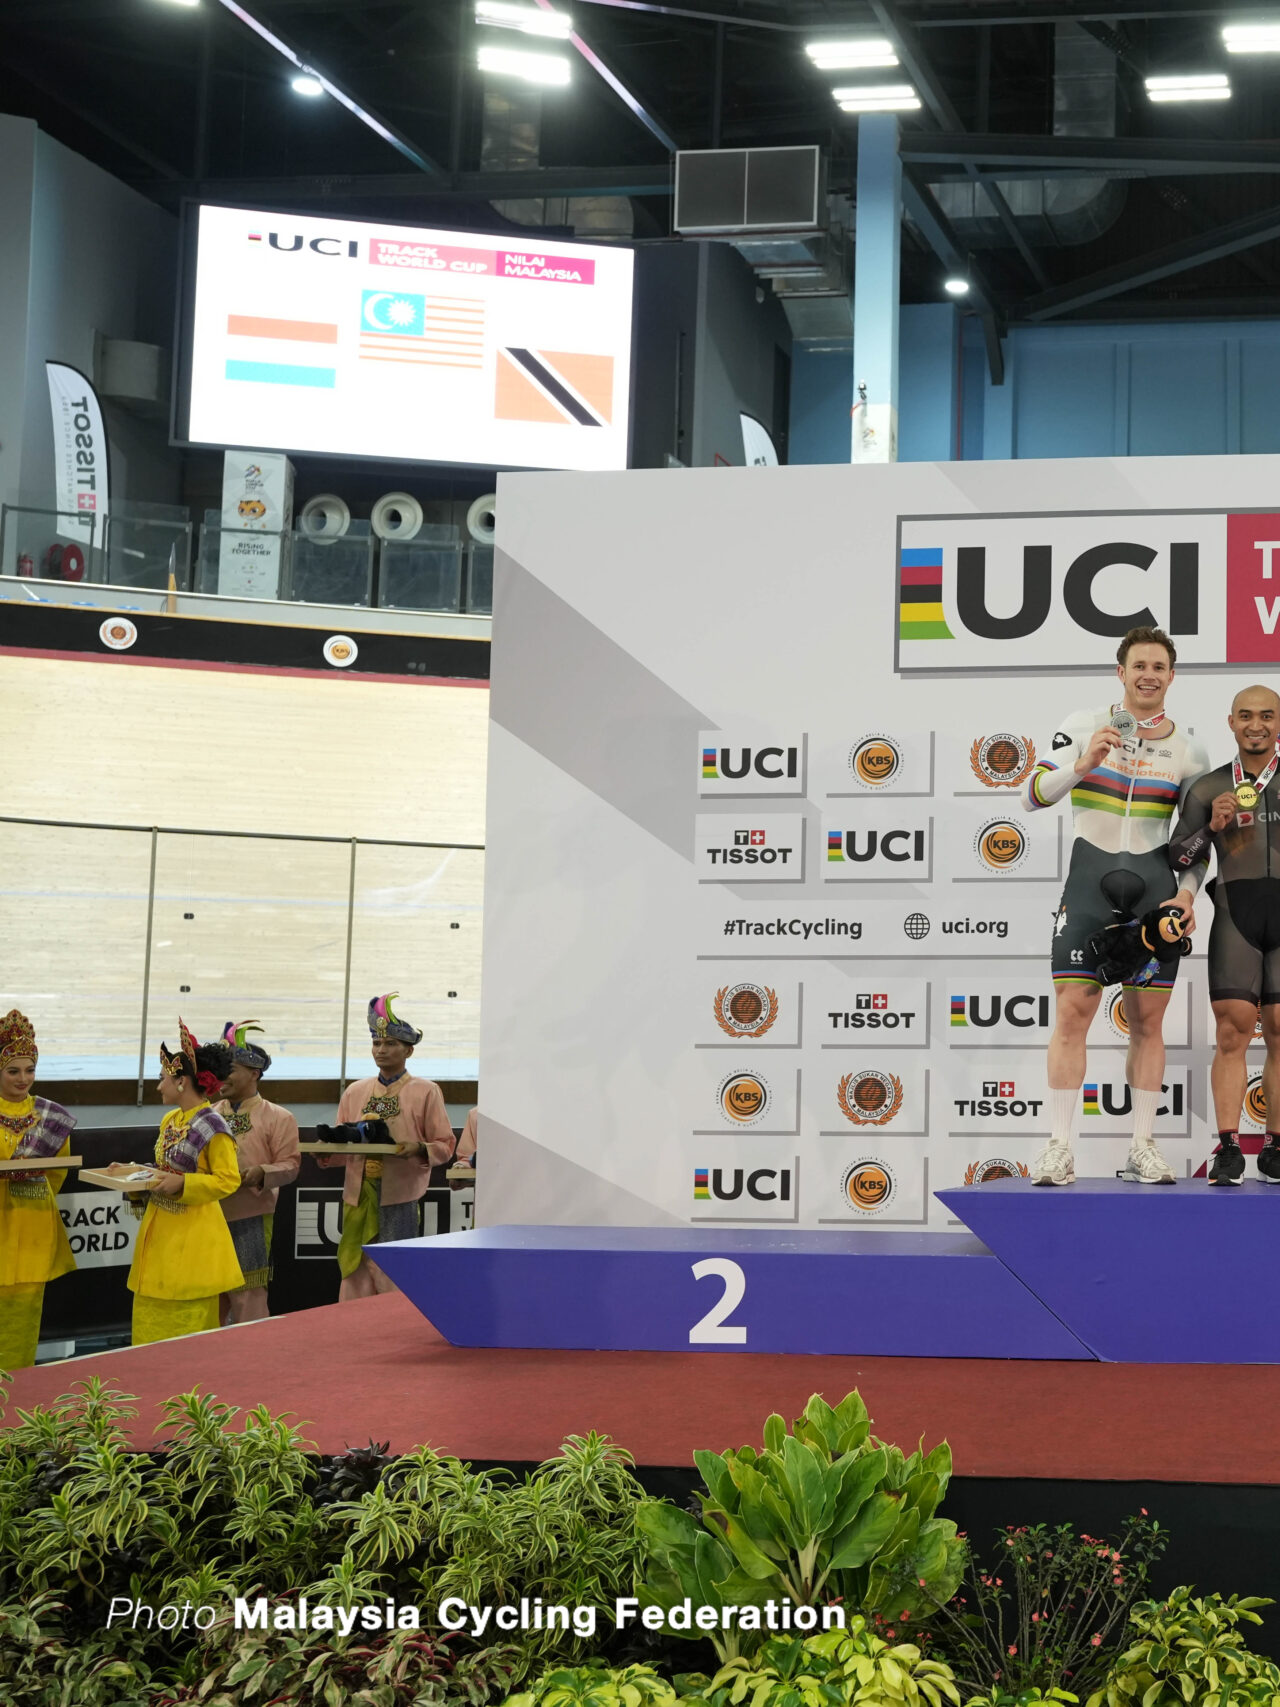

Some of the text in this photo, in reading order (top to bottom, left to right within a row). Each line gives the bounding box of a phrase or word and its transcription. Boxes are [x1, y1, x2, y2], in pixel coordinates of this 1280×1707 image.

[269, 233, 358, 258] UCI
[377, 243, 438, 258] TRACK
[377, 253, 488, 273] WORLD CUP
[505, 254, 545, 267] NILAI
[505, 265, 582, 281] MALAYSIA
[956, 542, 1198, 639] UCI
[721, 748, 797, 778] UCI
[868, 755, 891, 767] KBS
[846, 830, 924, 862] UCI
[992, 839, 1017, 850] KBS
[1186, 837, 1204, 858] CIMB
[707, 849, 792, 864] TISSOT
[723, 918, 863, 940] #TrackCycling
[942, 918, 1009, 938] uci.org
[828, 1013, 915, 1028] TISSOT
[969, 995, 1049, 1027] UCI
[735, 1092, 759, 1103] KBS
[955, 1100, 1043, 1116] TISSOT
[712, 1169, 791, 1200] UCI
[859, 1180, 885, 1191] KBS
[324, 1202, 438, 1244] UI
[68, 1232, 129, 1254] ORLD
[688, 1258, 747, 1344] 2
